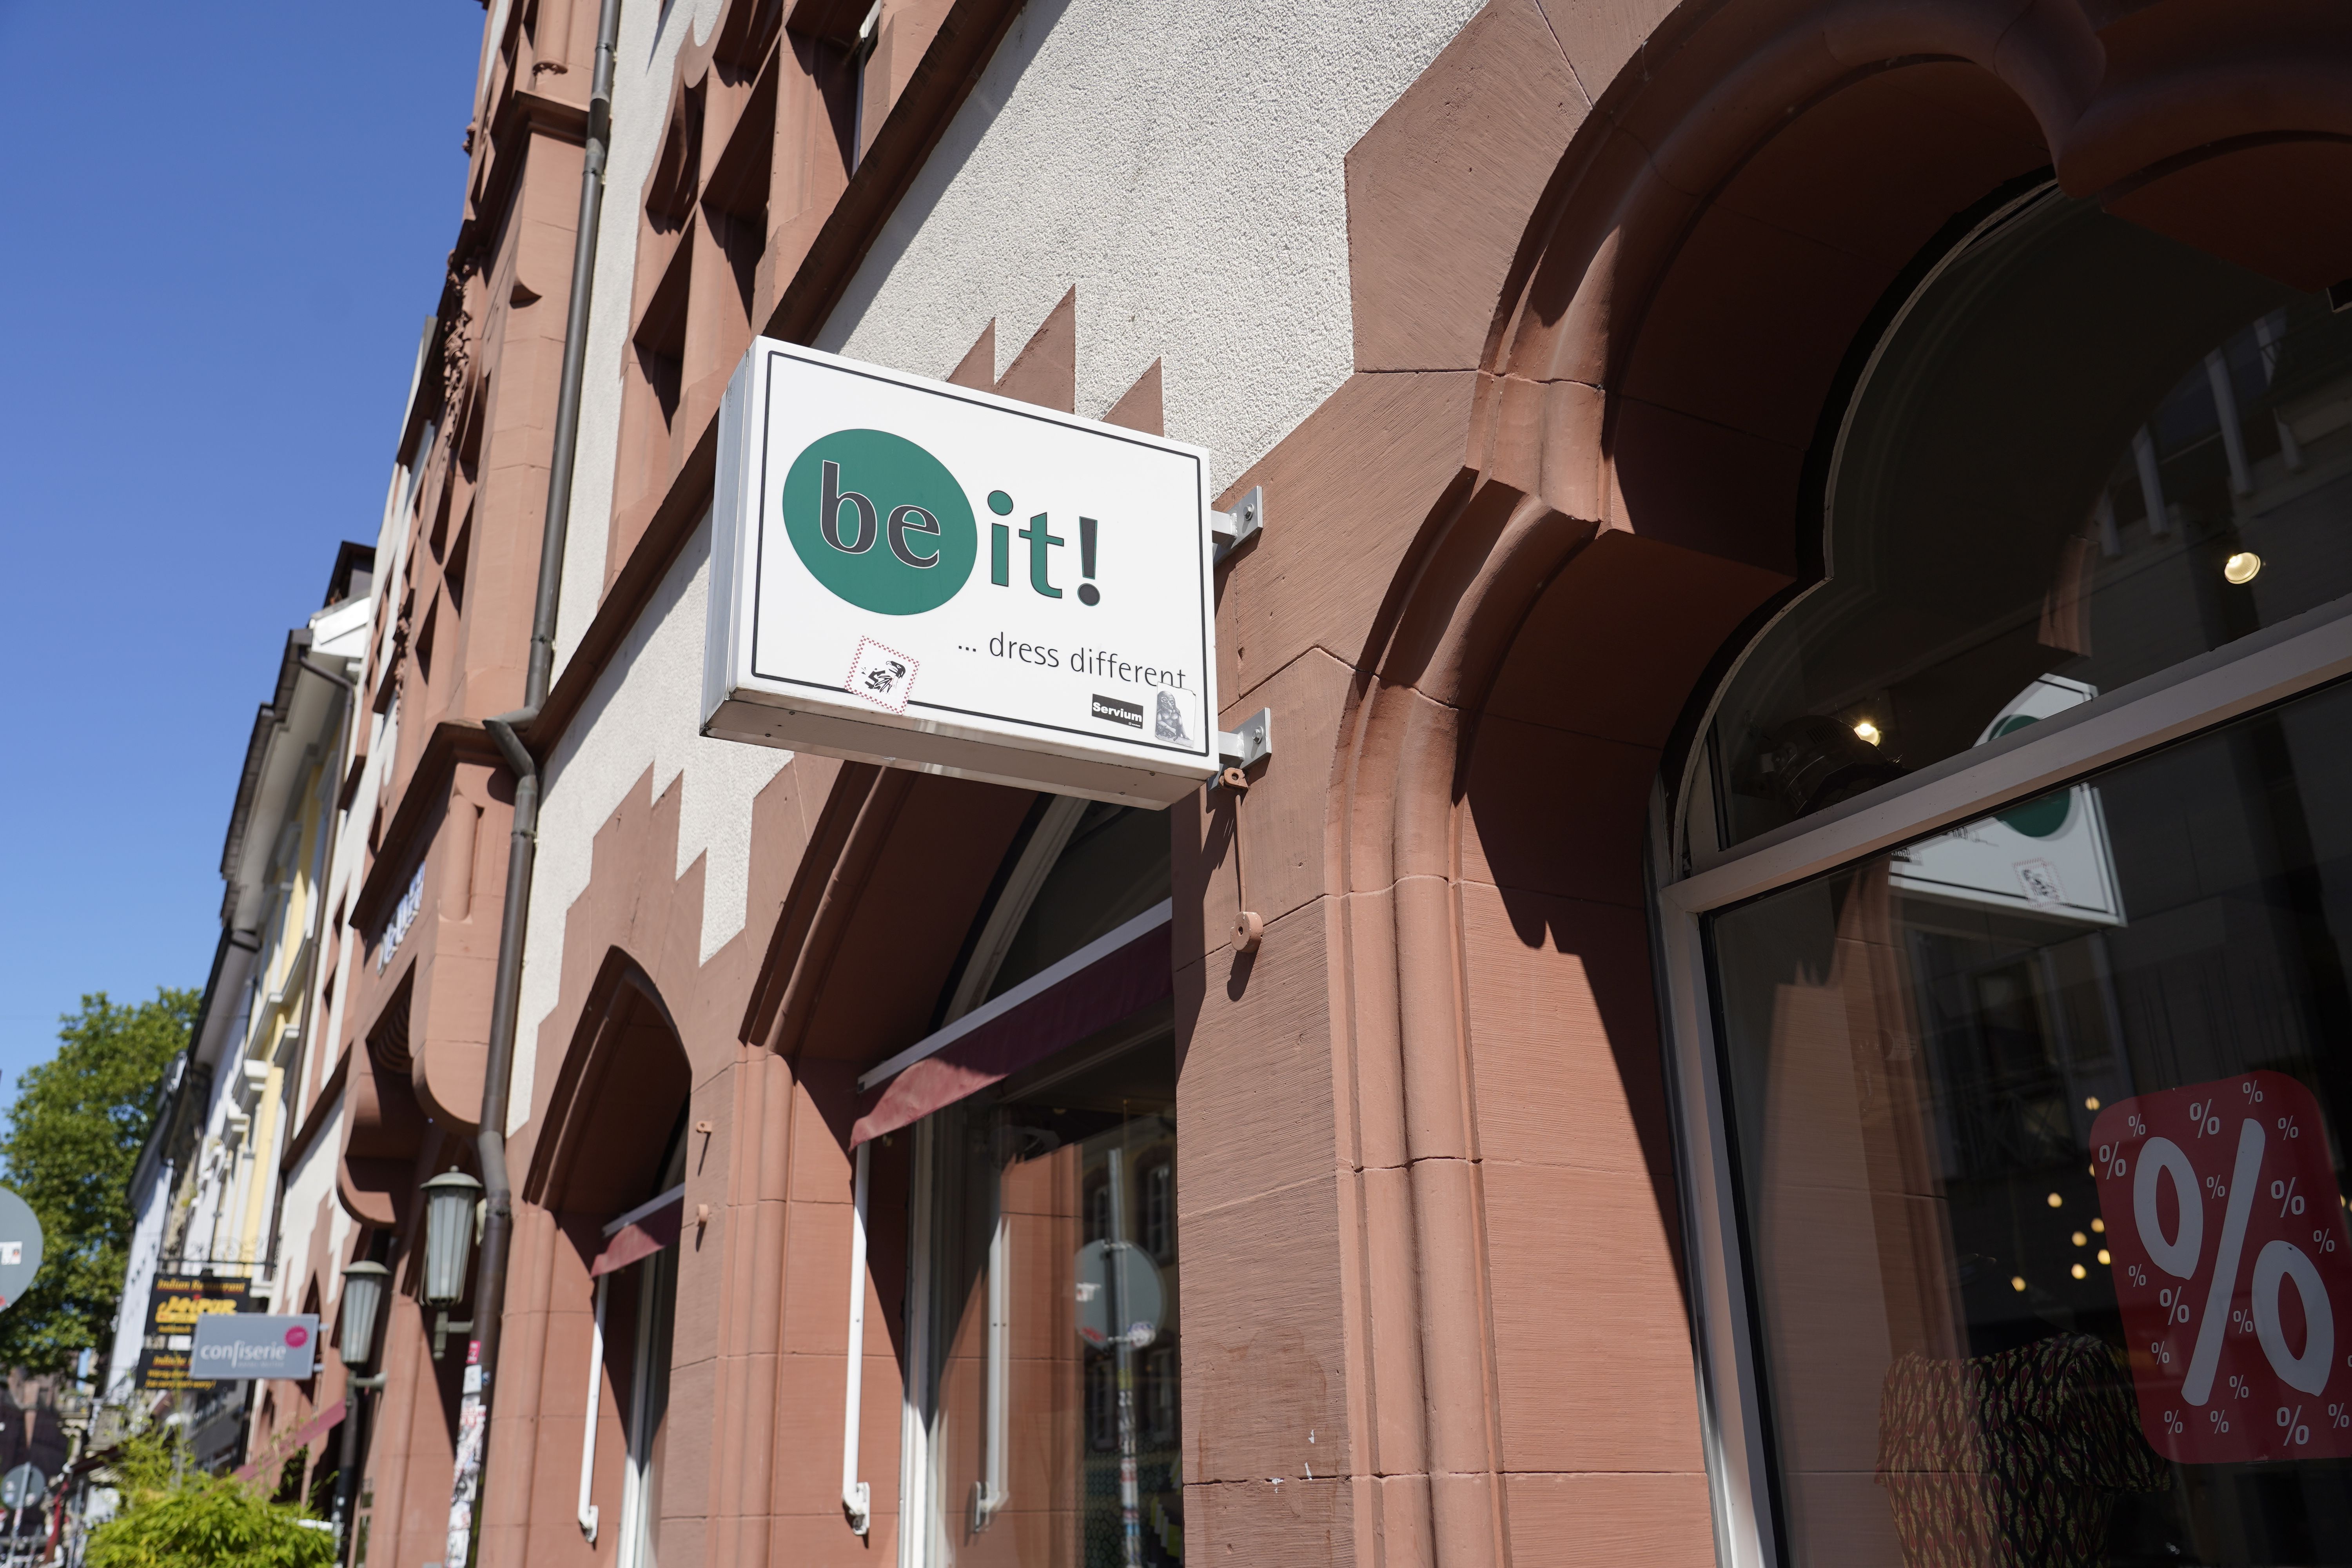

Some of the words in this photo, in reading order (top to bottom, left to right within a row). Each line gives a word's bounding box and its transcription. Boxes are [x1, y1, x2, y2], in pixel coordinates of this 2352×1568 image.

[819, 459, 941, 570] be
[987, 490, 1101, 607] it!
[989, 632, 1060, 668] dress
[1070, 647, 1186, 689] different
[1092, 702, 1142, 722] Servium
[200, 1339, 287, 1368] confiserie
